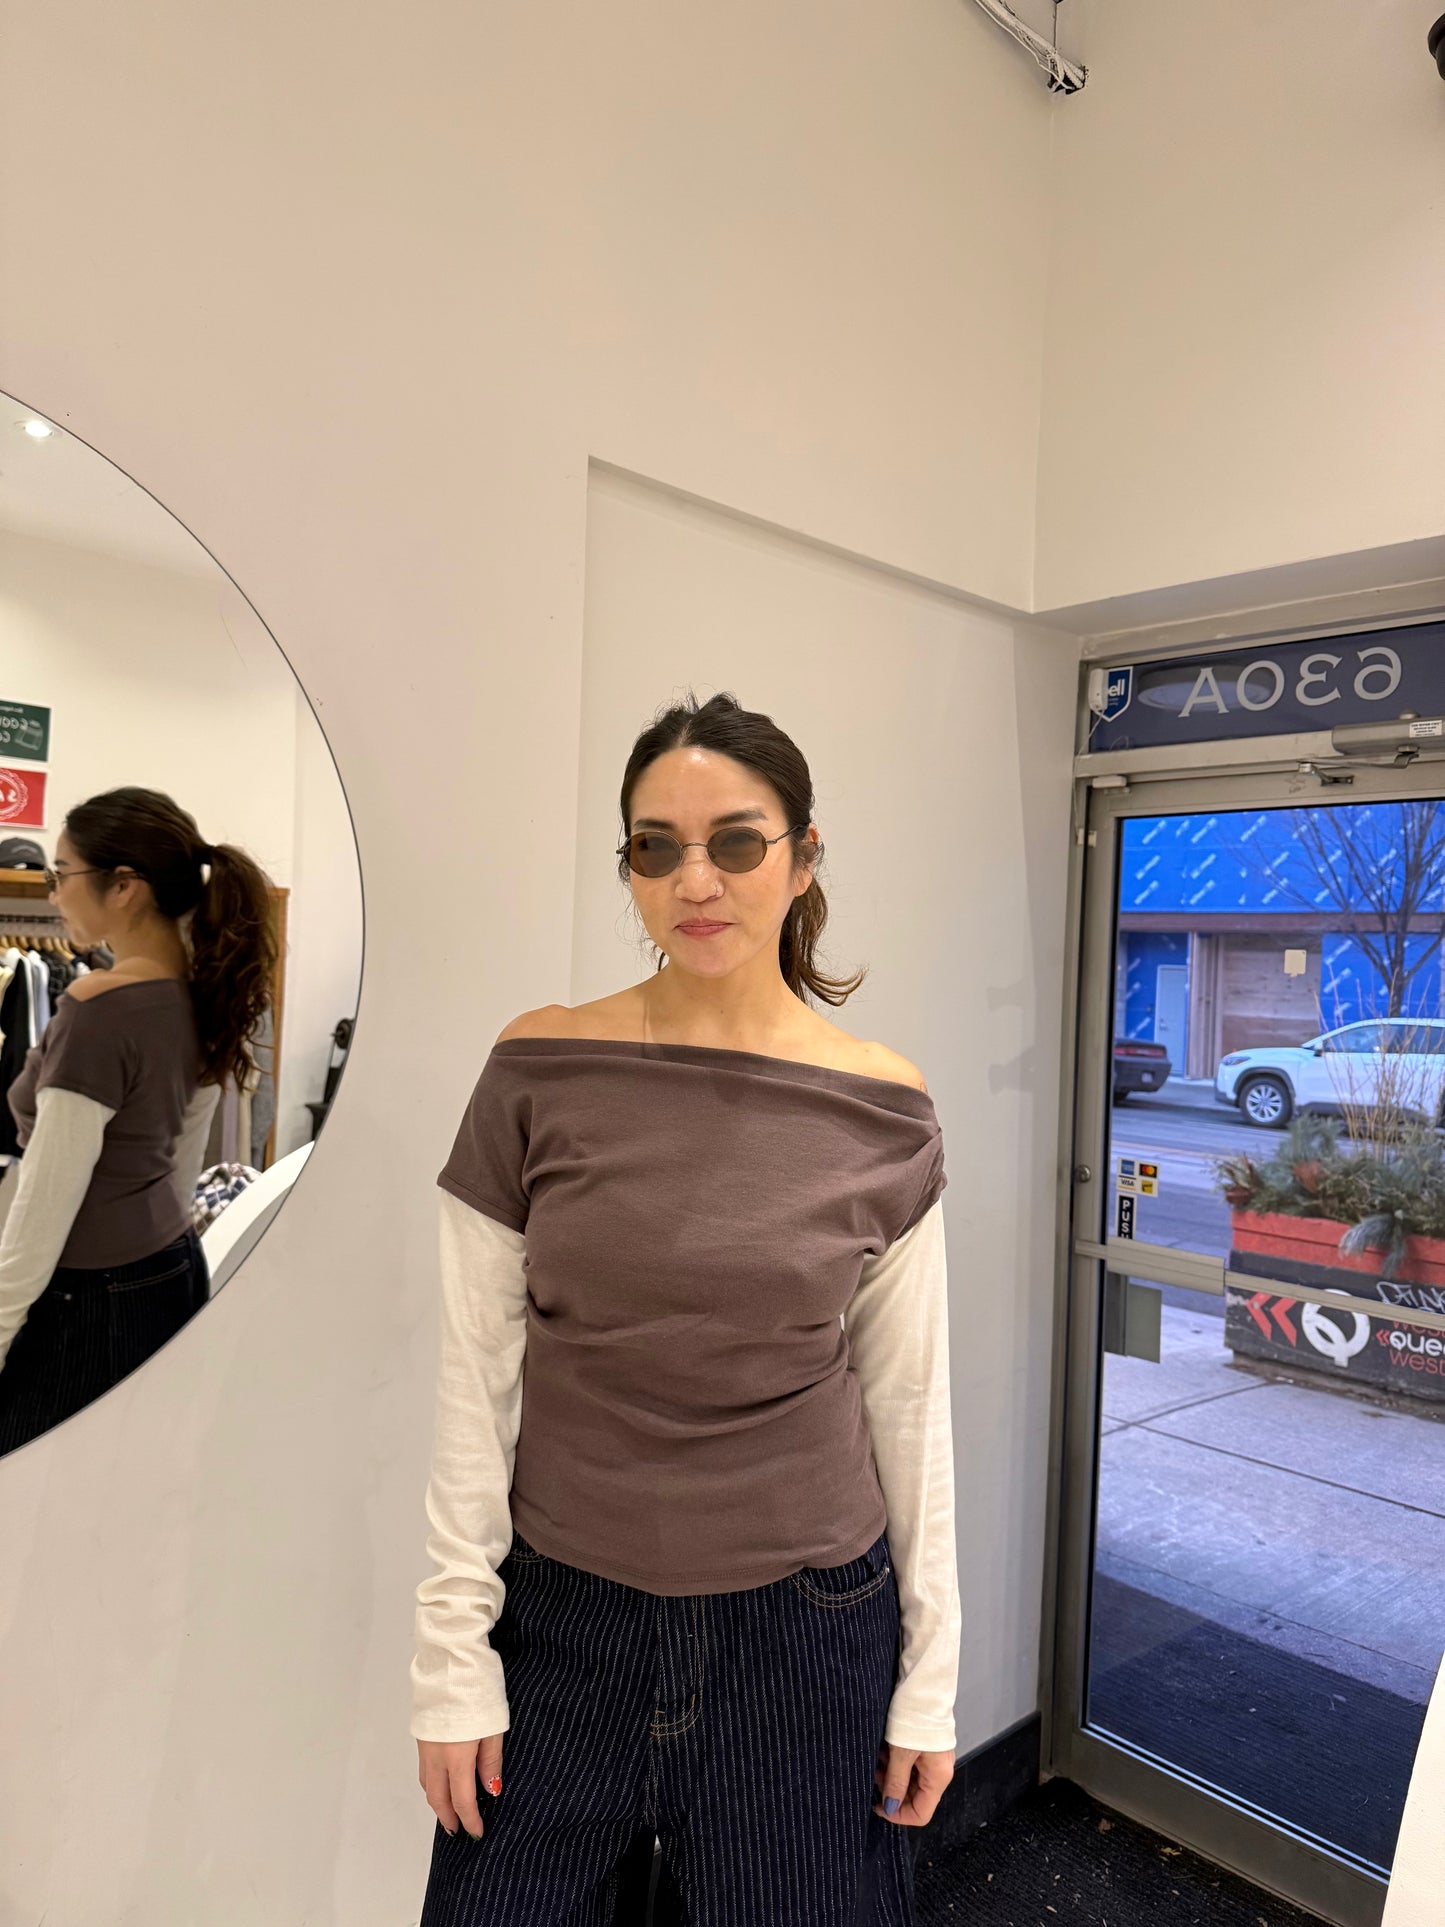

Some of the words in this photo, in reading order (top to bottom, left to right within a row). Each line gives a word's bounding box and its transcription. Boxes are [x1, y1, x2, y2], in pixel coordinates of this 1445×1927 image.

[1107, 678, 1126, 697] ell
[1120, 1178, 1135, 1187] VISA
[1389, 1331, 1445, 1357] Que
